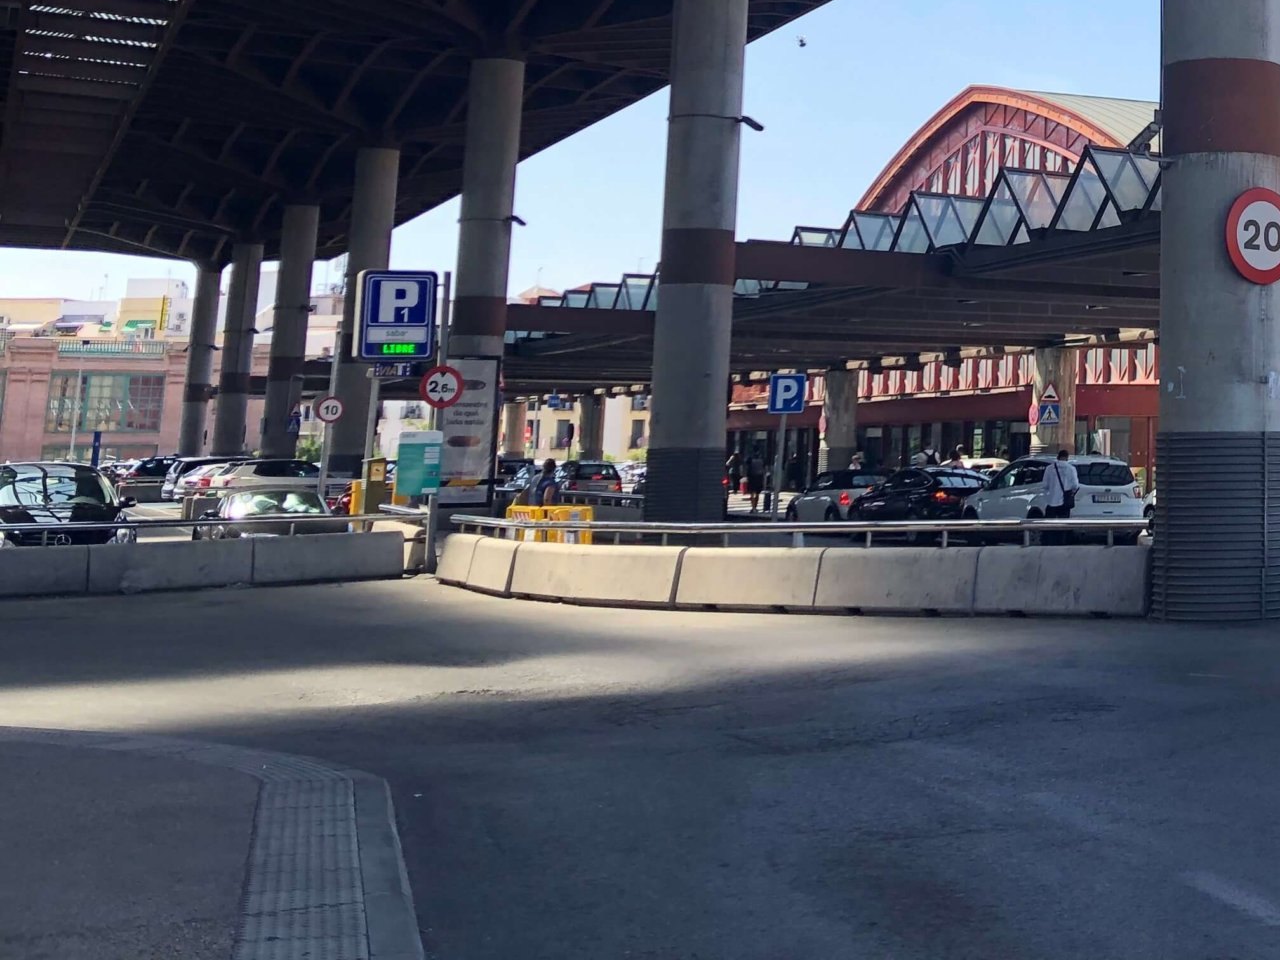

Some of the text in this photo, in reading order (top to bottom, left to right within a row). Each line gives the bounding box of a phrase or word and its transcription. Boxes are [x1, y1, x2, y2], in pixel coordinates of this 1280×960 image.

[383, 344, 415, 354] LIBRE
[775, 379, 799, 409] P
[324, 405, 338, 416] 10
